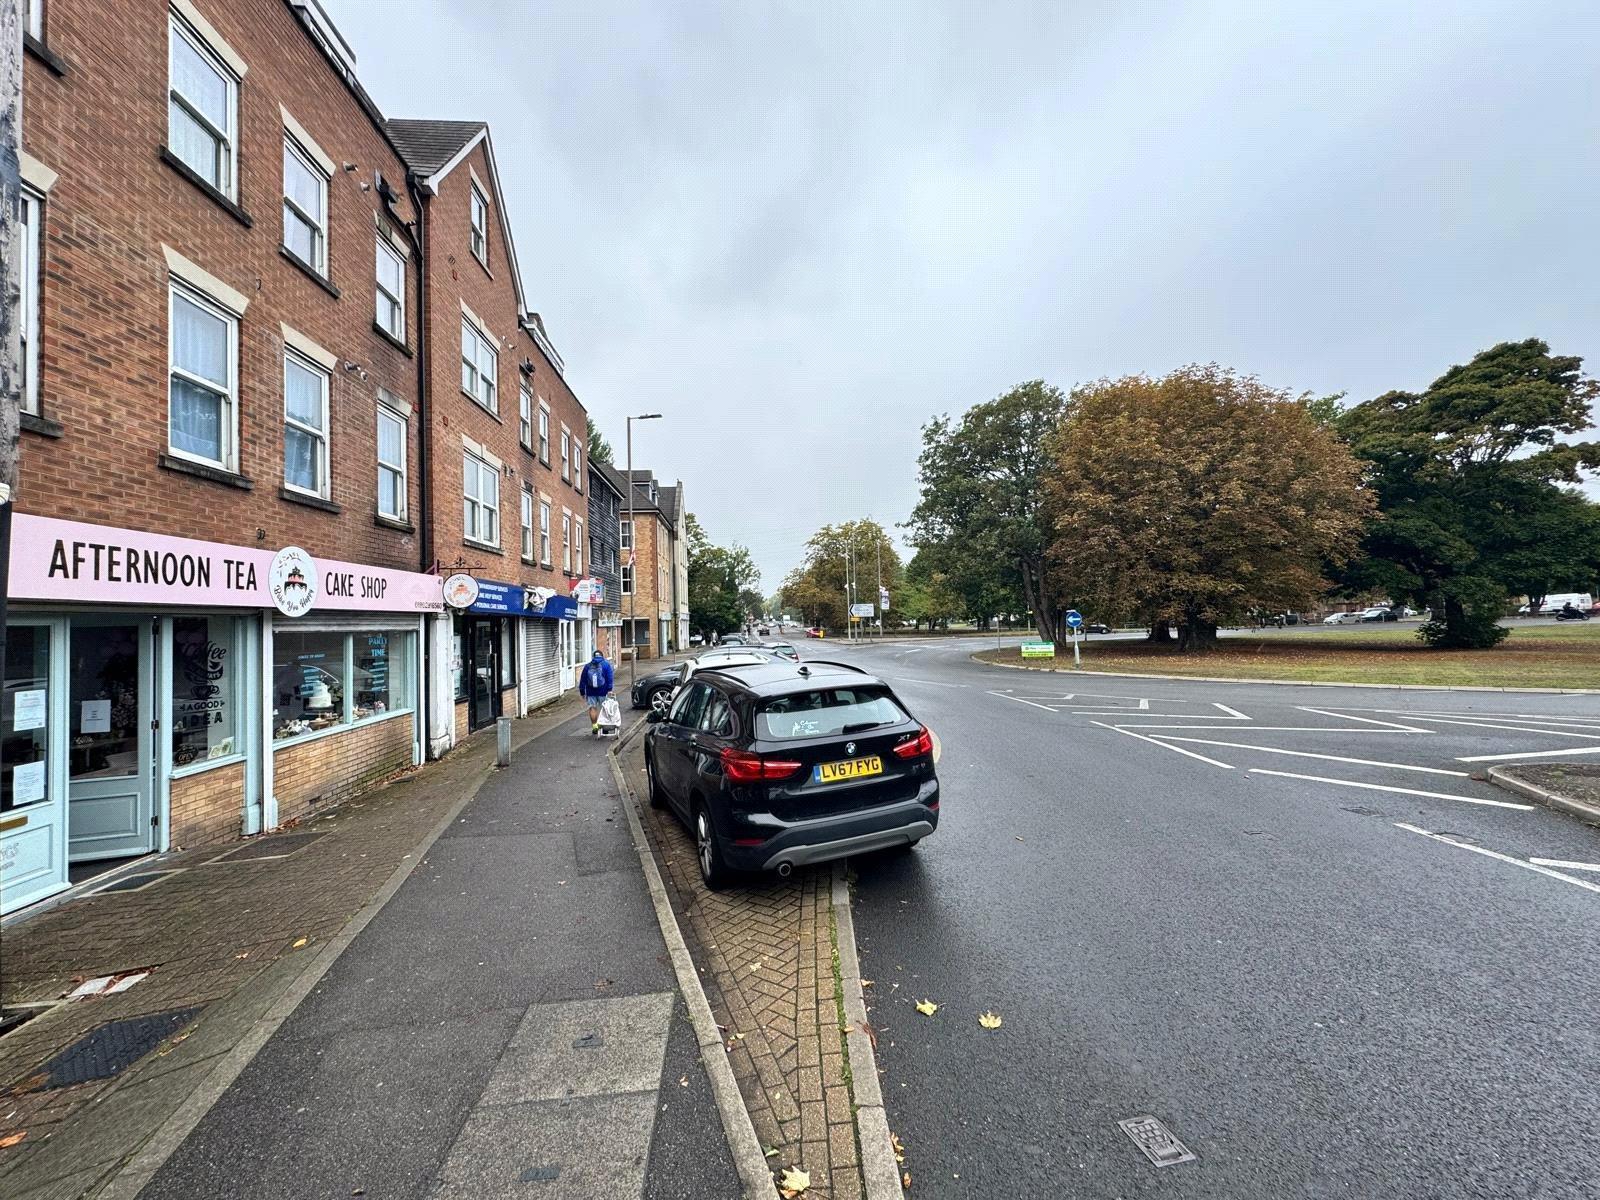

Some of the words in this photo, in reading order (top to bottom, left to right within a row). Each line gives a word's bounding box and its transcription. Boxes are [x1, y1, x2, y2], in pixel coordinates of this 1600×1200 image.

[48, 539, 211, 587] AFTERNOON
[223, 559, 258, 591] TEA
[325, 572, 354, 597] CAKE
[361, 576, 387, 599] SHOP
[371, 648, 385, 656] TIME
[188, 703, 194, 711] A
[194, 701, 219, 711] GOOD
[182, 711, 223, 727] IDEA
[897, 734, 910, 742] X1
[821, 761, 853, 778] LV67
[855, 758, 880, 773] FYG
